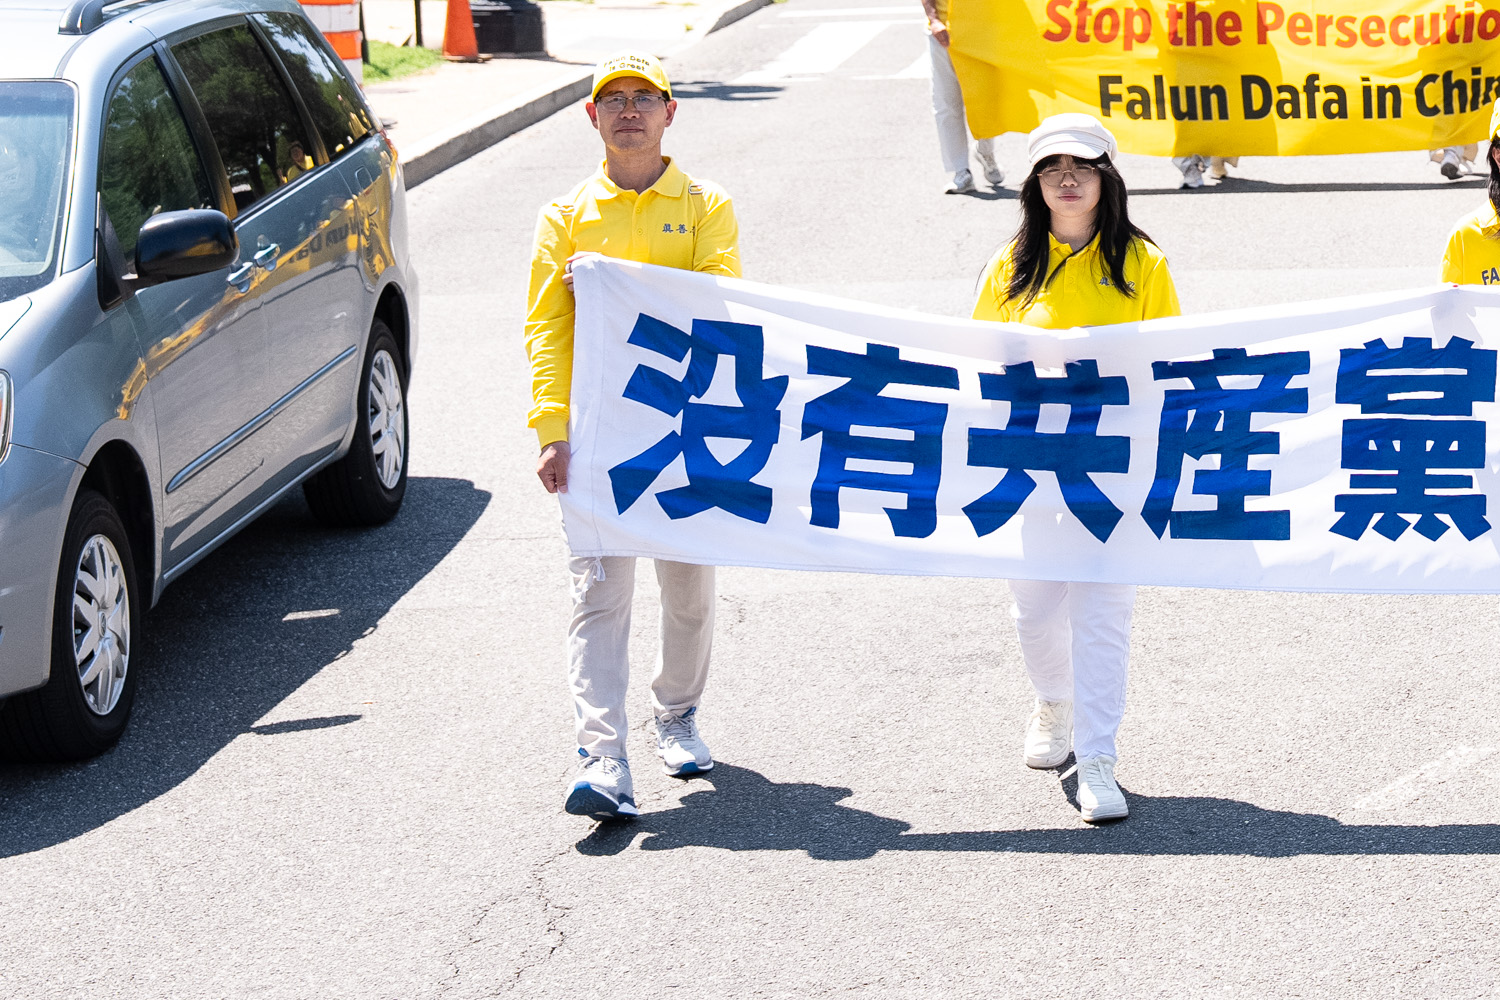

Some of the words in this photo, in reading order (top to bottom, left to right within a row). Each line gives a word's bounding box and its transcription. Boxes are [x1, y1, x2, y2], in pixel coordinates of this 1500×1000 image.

[1168, 1, 1243, 47] the
[1099, 74, 1230, 121] Falun
[1240, 73, 1348, 121] Dafa
[1361, 77, 1403, 120] in
[607, 311, 1498, 544] 没有共産黨
